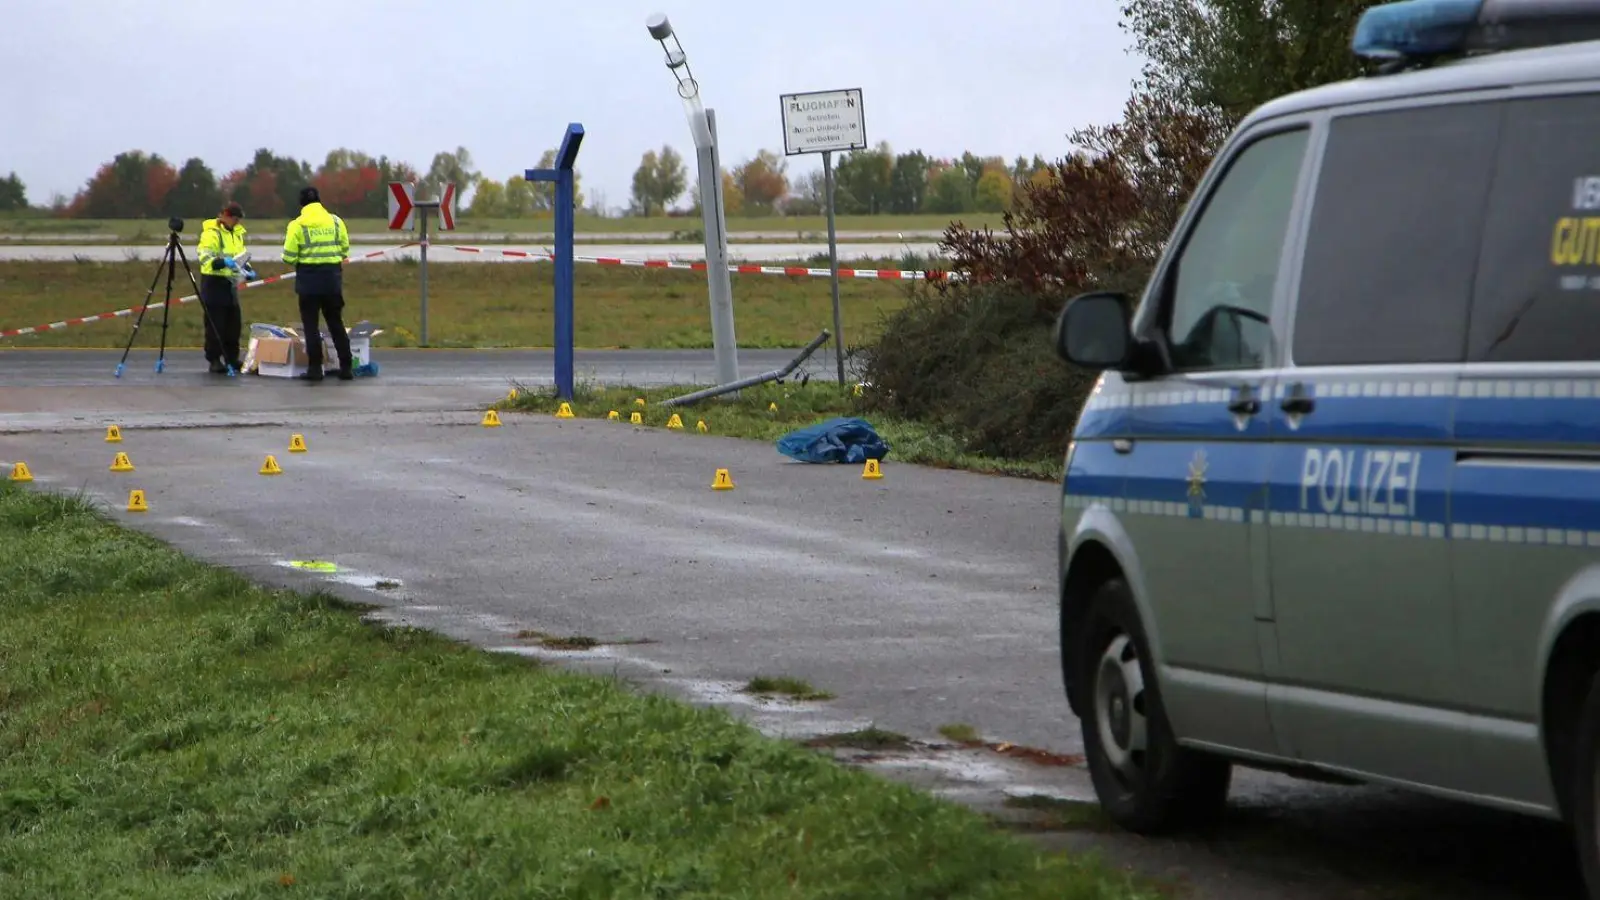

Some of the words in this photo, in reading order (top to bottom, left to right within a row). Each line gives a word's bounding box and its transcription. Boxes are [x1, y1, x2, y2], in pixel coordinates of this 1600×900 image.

[310, 228, 334, 237] POLIZEI
[1551, 217, 1600, 265] GUT
[294, 437, 300, 447] 6
[869, 462, 875, 473] 8
[720, 473, 726, 483] 7
[1301, 448, 1420, 517] POLIZEI
[134, 494, 141, 505] 2
